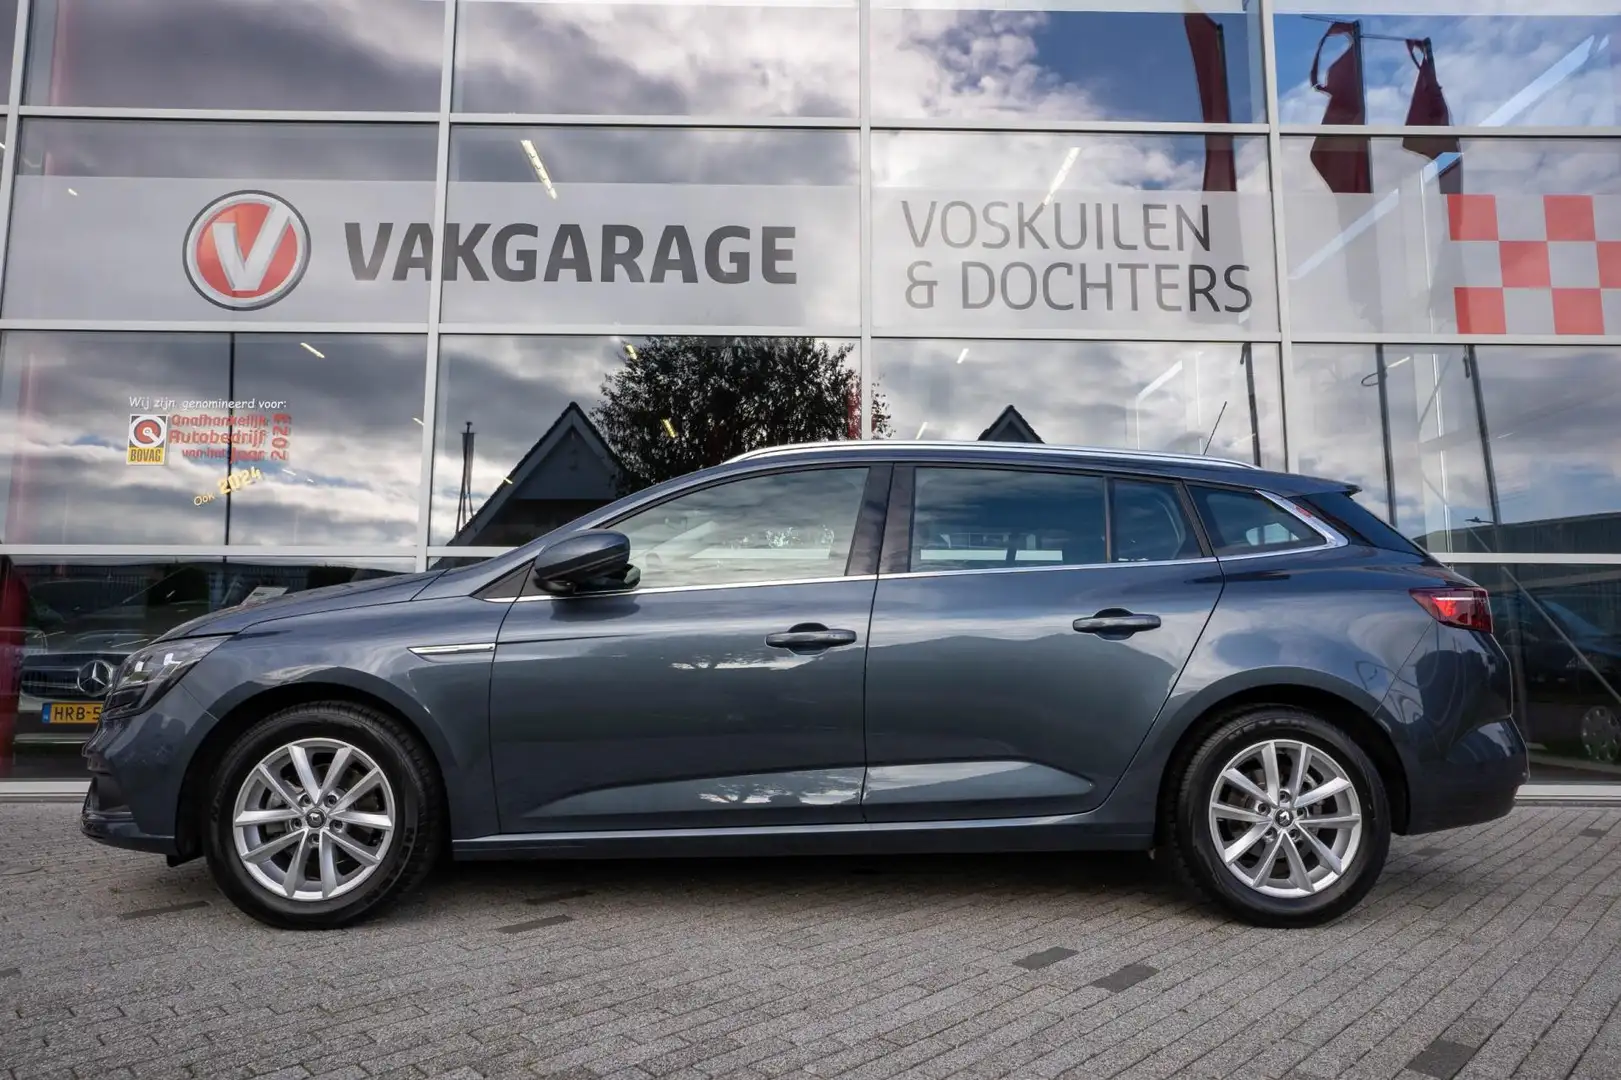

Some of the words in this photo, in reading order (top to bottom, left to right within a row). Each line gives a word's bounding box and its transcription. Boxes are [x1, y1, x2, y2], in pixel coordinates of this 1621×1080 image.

[900, 199, 1211, 252] VOSKUILEN
[345, 222, 797, 285] VAKGARAGE
[905, 260, 938, 309] &
[962, 261, 1253, 313] DOCHTERS
[129, 396, 149, 410] Wij
[153, 397, 175, 410] zijn
[182, 398, 255, 410] genomineerd
[259, 400, 287, 409] voor:
[171, 413, 268, 429] Onafhankelijk
[168, 429, 267, 447] Autobedrijf
[130, 449, 161, 462] BOVAG
[193, 492, 215, 506] Ook
[218, 467, 262, 495] 2024
